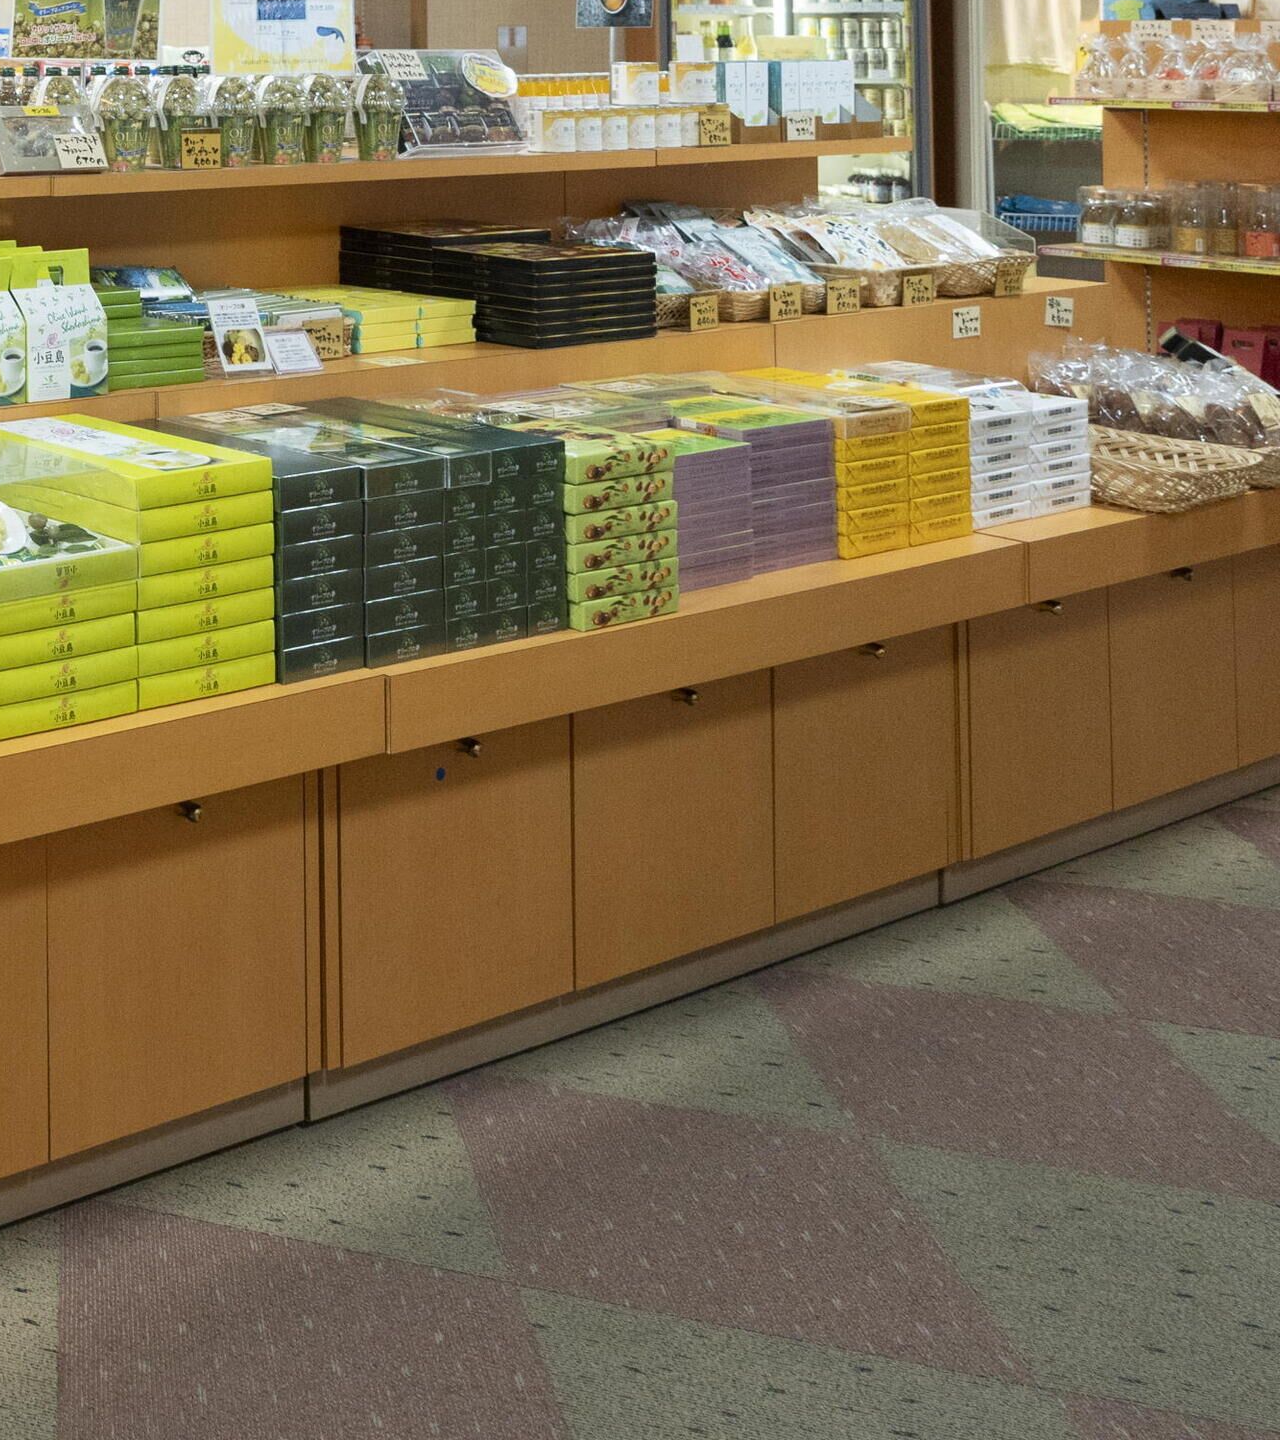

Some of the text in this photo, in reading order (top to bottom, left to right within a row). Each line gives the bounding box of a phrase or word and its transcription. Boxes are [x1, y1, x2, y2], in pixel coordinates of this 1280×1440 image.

[34, 350, 64, 365] 小豆島
[196, 484, 217, 497] 小豆島
[197, 517, 218, 529] 小豆島
[197, 550, 218, 562] 小豆島
[197, 583, 218, 595] 小豆島
[53, 608, 76, 621] 小豆島
[198, 615, 219, 628] 小豆島
[51, 642, 74, 655] 小豆島
[198, 648, 219, 661] 小豆島
[54, 677, 77, 690] 小豆島
[198, 681, 220, 693] 小豆島
[53, 711, 77, 724] 小豆島
